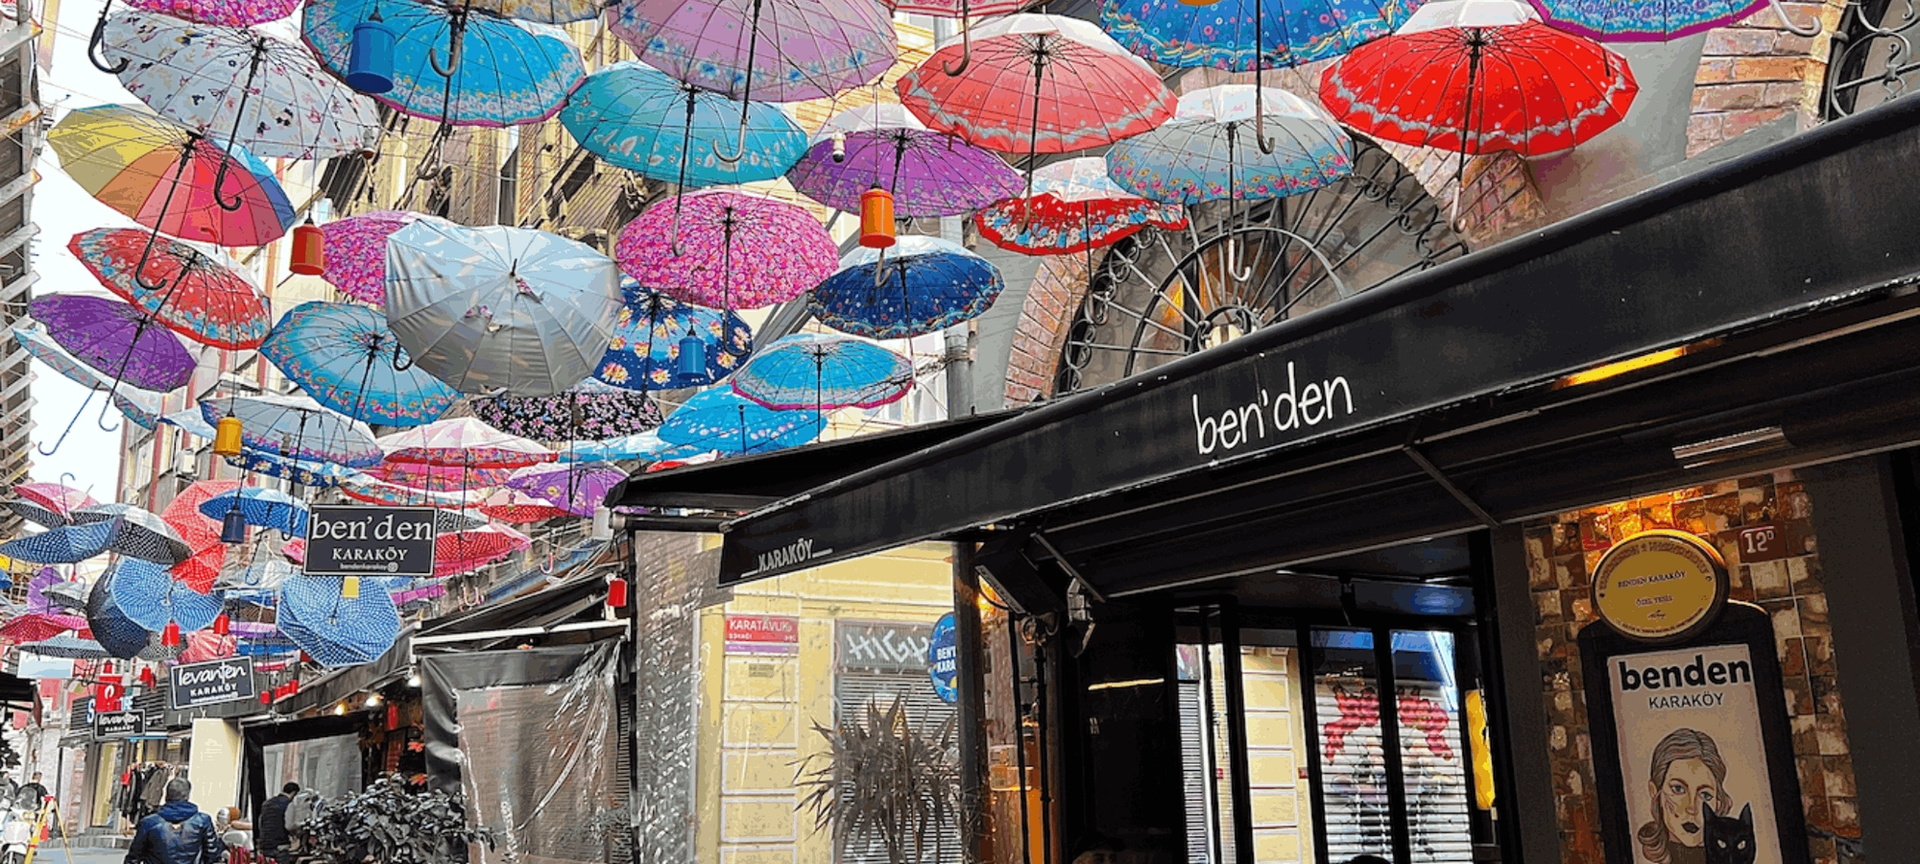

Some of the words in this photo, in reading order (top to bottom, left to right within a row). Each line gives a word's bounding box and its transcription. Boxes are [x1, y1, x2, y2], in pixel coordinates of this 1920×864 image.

[1192, 360, 1353, 455] ben'den
[332, 546, 408, 560] KARAKÖY
[758, 538, 813, 573] KARAKÖY
[1649, 570, 1686, 582] KARAKÖY
[179, 661, 246, 686] levanten
[1618, 654, 1751, 691] benden
[190, 683, 237, 697] KARAKÖY
[1649, 691, 1724, 709] KARAKÖY
